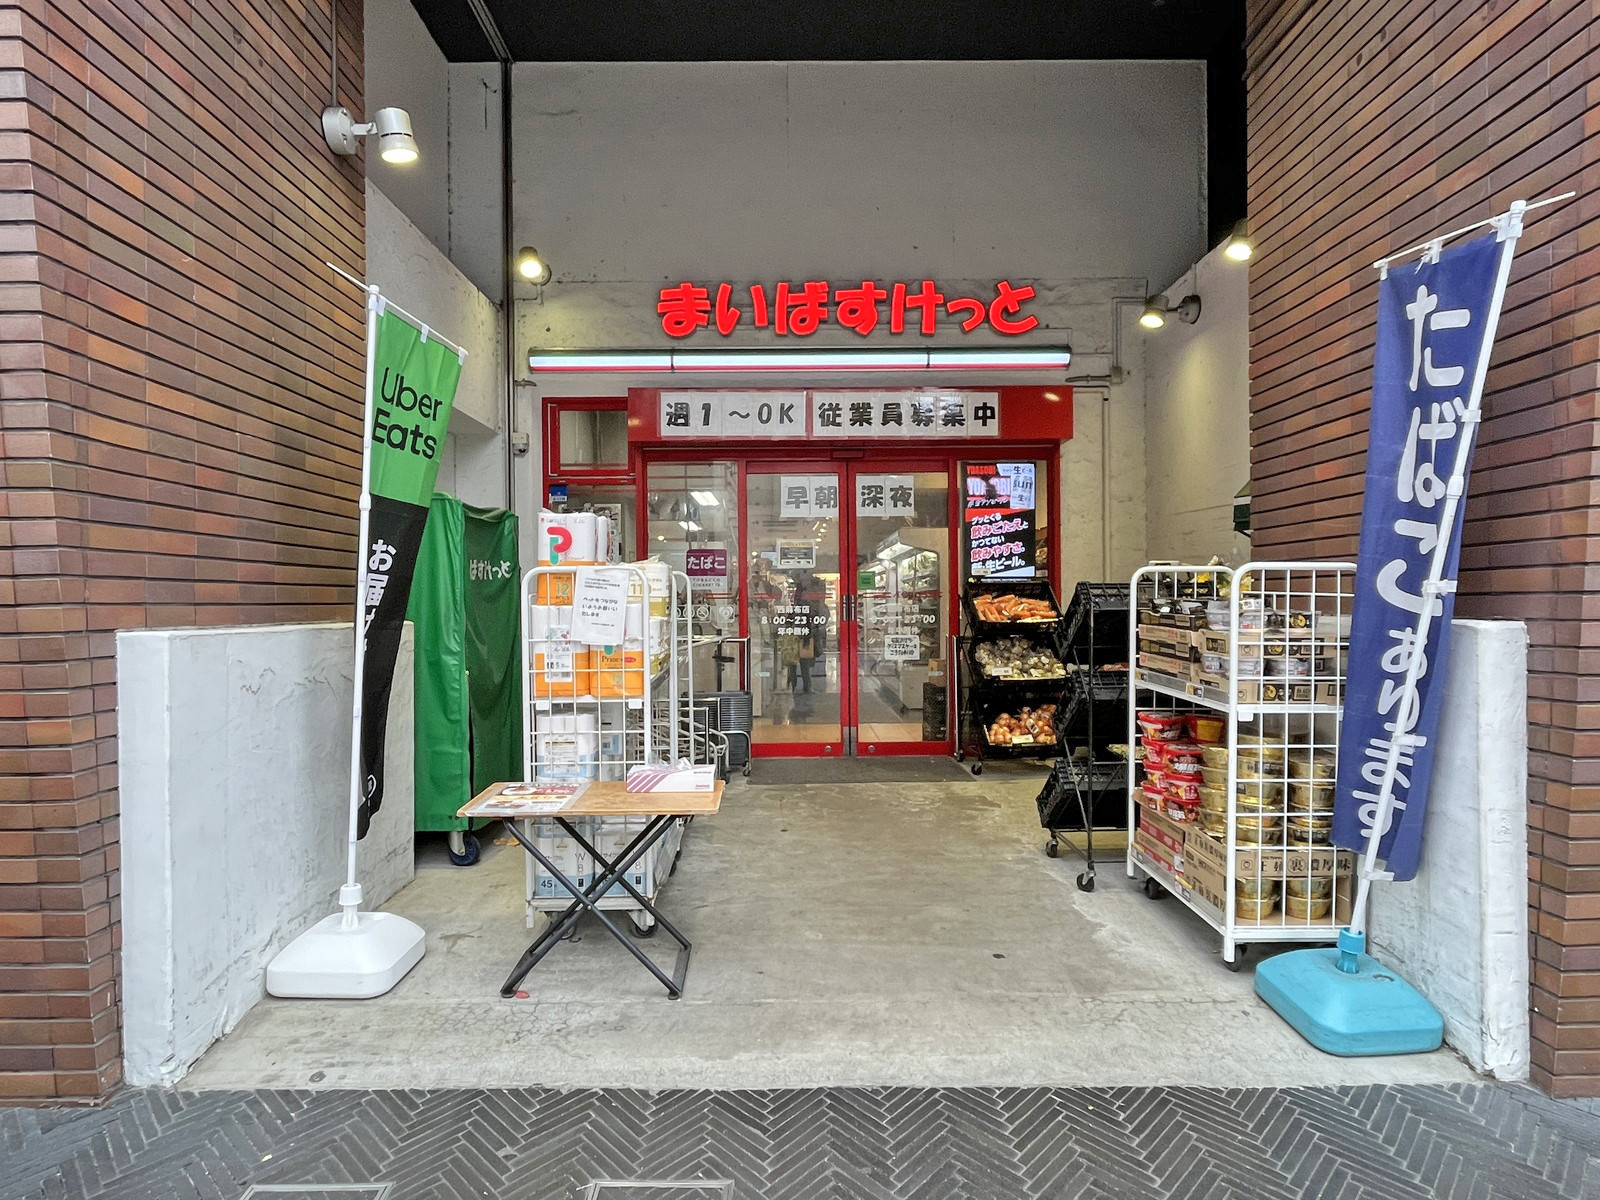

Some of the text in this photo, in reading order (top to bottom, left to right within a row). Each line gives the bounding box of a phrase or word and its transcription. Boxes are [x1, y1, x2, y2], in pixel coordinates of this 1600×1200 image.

[656, 280, 1039, 336] まいばすけっと
[381, 367, 442, 421] Uber
[818, 402, 996, 427] 従業員募集中
[372, 407, 437, 459] Eats
[786, 485, 913, 509] 早朝 深夜
[971, 518, 1029, 539] 飲みごたえと
[972, 512, 1002, 525] グッとくる
[972, 536, 1005, 548] かつてない
[687, 556, 726, 569] たばこ
[1352, 285, 1470, 838] たばこあります
[540, 880, 553, 888] 45
